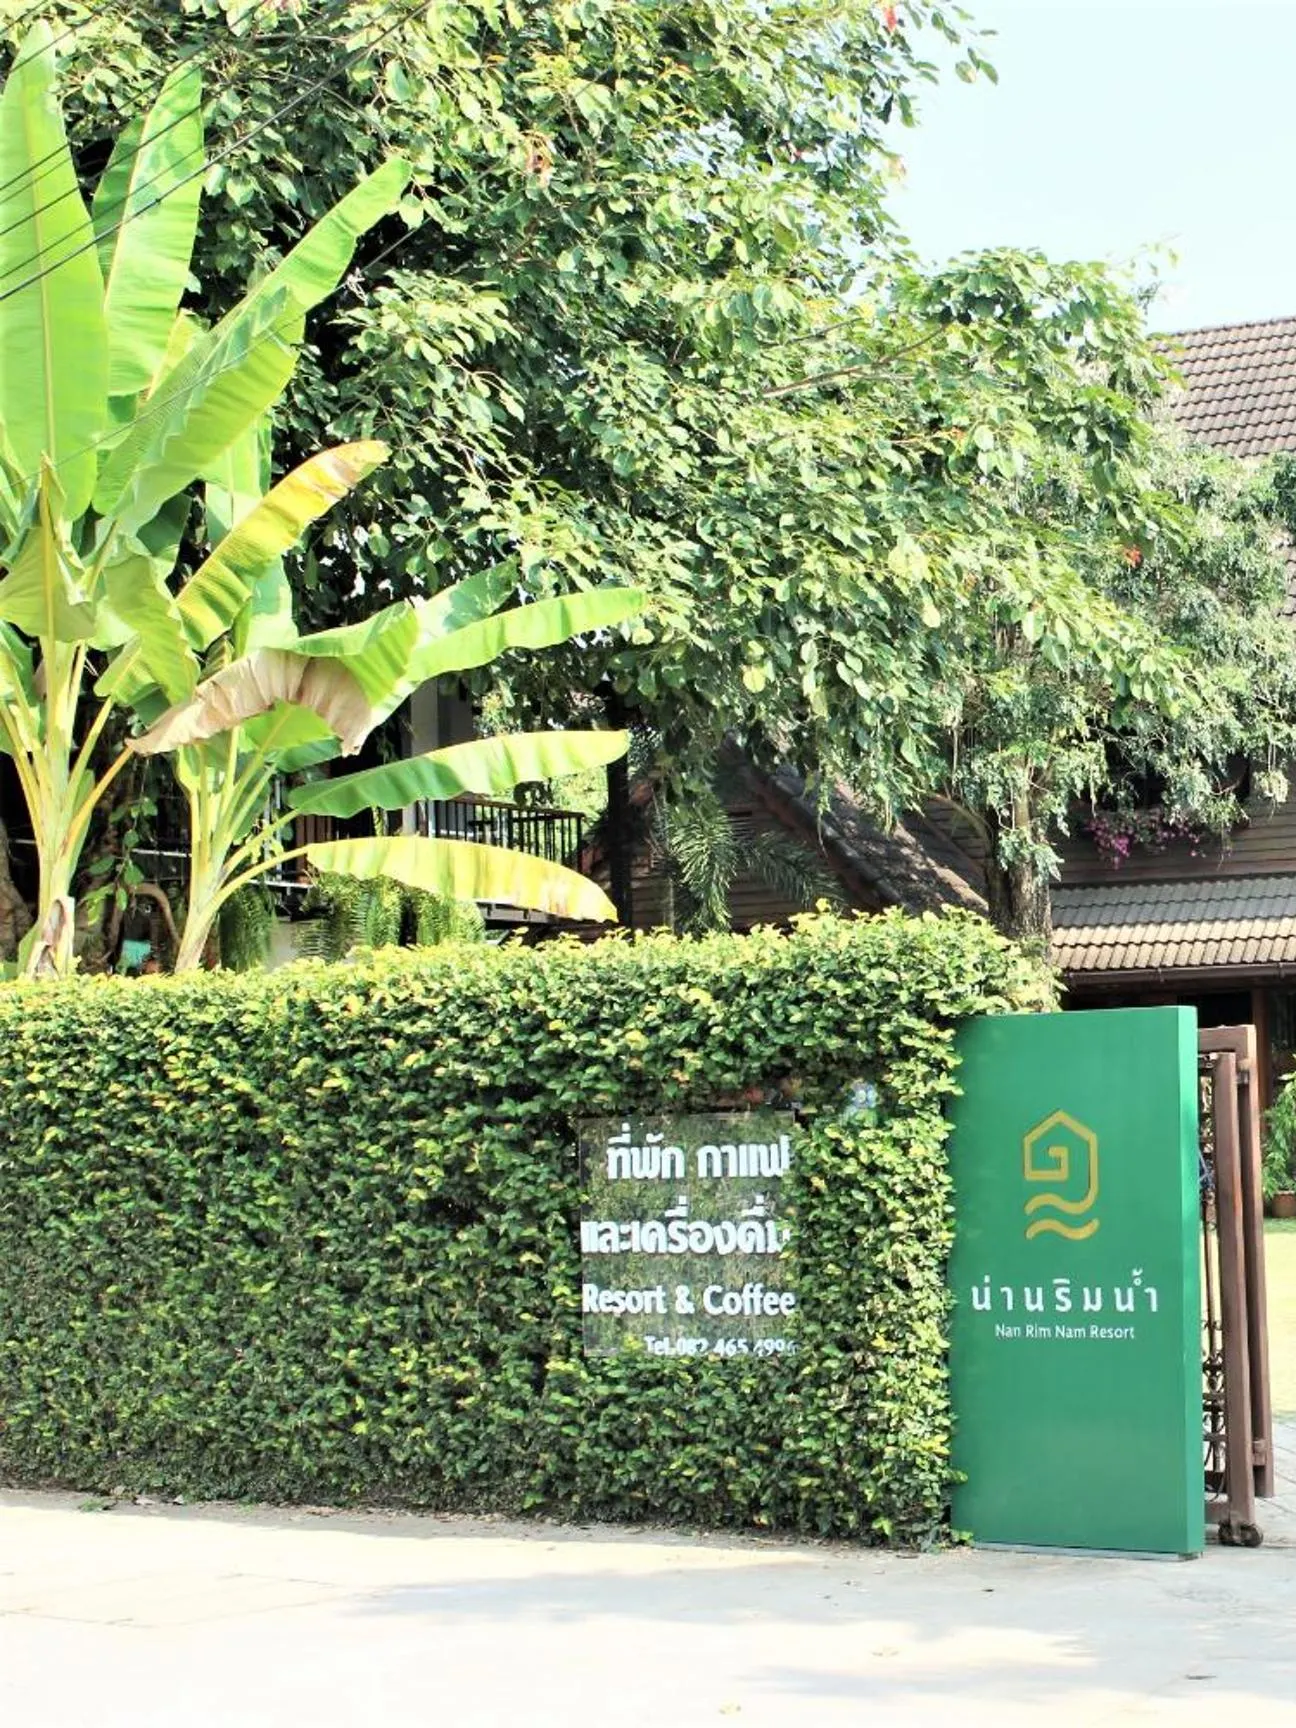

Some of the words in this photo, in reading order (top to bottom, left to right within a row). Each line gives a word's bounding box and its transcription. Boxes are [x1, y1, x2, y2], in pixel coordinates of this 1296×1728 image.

[606, 1122, 685, 1179] ที่พัก
[697, 1134, 790, 1178] กาแฟ
[582, 1283, 667, 1316] Resort
[675, 1285, 695, 1314] &
[703, 1283, 796, 1315] Coffee
[971, 1267, 1158, 1313] น่านริมน้ำ
[713, 1338, 748, 1357] 465
[995, 1324, 1020, 1338] Nan
[1025, 1323, 1051, 1338] Rim
[1055, 1324, 1086, 1338] Nam
[1089, 1324, 1135, 1339] Resort
